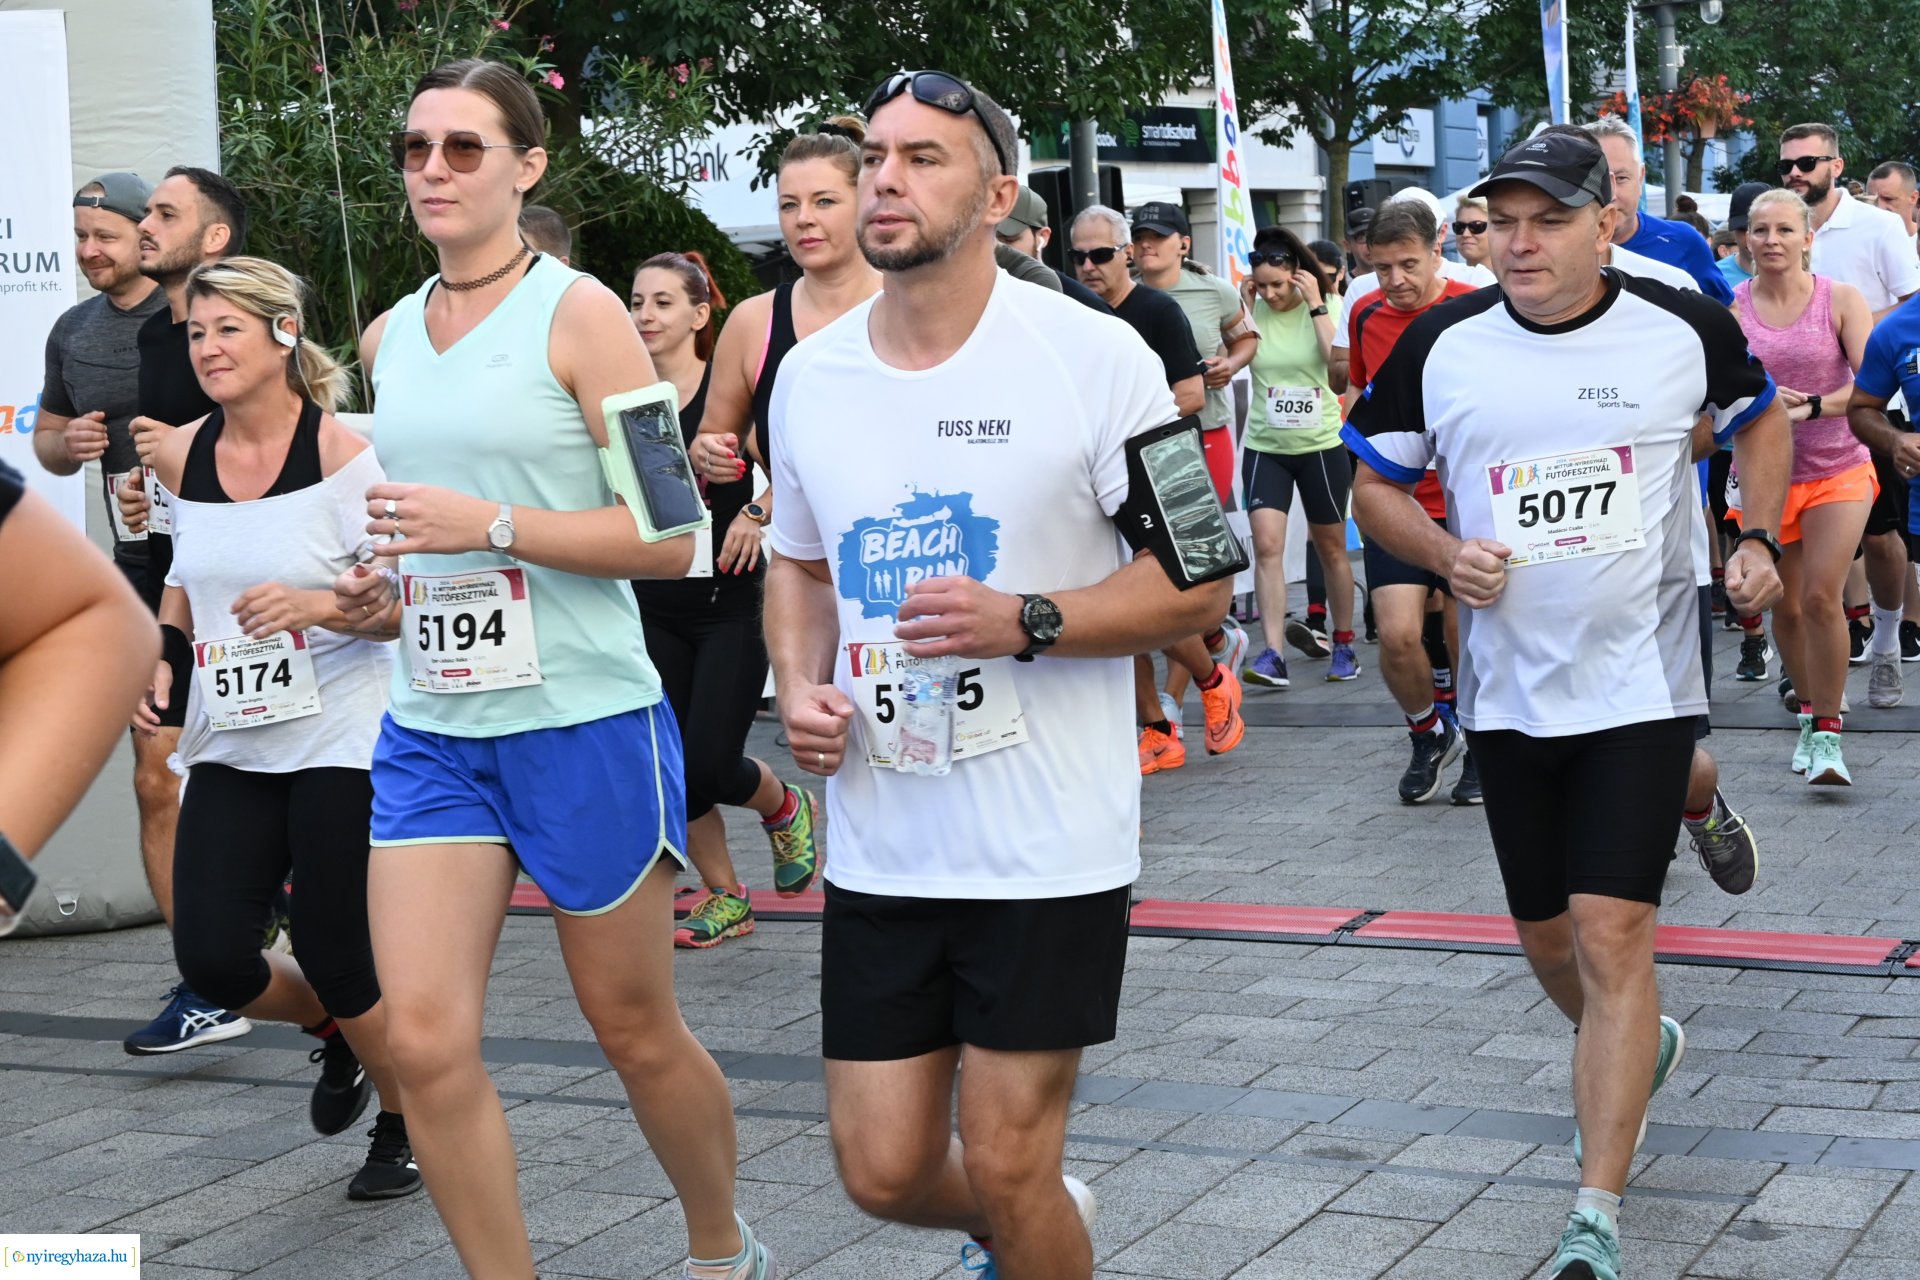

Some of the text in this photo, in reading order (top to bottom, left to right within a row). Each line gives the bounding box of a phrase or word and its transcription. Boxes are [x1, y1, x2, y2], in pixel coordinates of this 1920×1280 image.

[671, 142, 729, 182] Bank
[41, 281, 62, 292] Kft.
[1578, 387, 1619, 400] ZEISS
[1275, 400, 1314, 414] 5036
[1597, 400, 1640, 409] Sports Team
[938, 419, 1011, 437] FUSS NEKI
[1545, 463, 1611, 480] FUTÓFESZTIVÁL
[1518, 481, 1617, 528] 5077
[863, 526, 957, 564] BEACH
[432, 588, 499, 602] FUTÓFESZTIVÁL
[419, 609, 506, 651] 5194
[231, 642, 285, 658] FUTÓFESZTIVÁL
[216, 658, 293, 698] 5174
